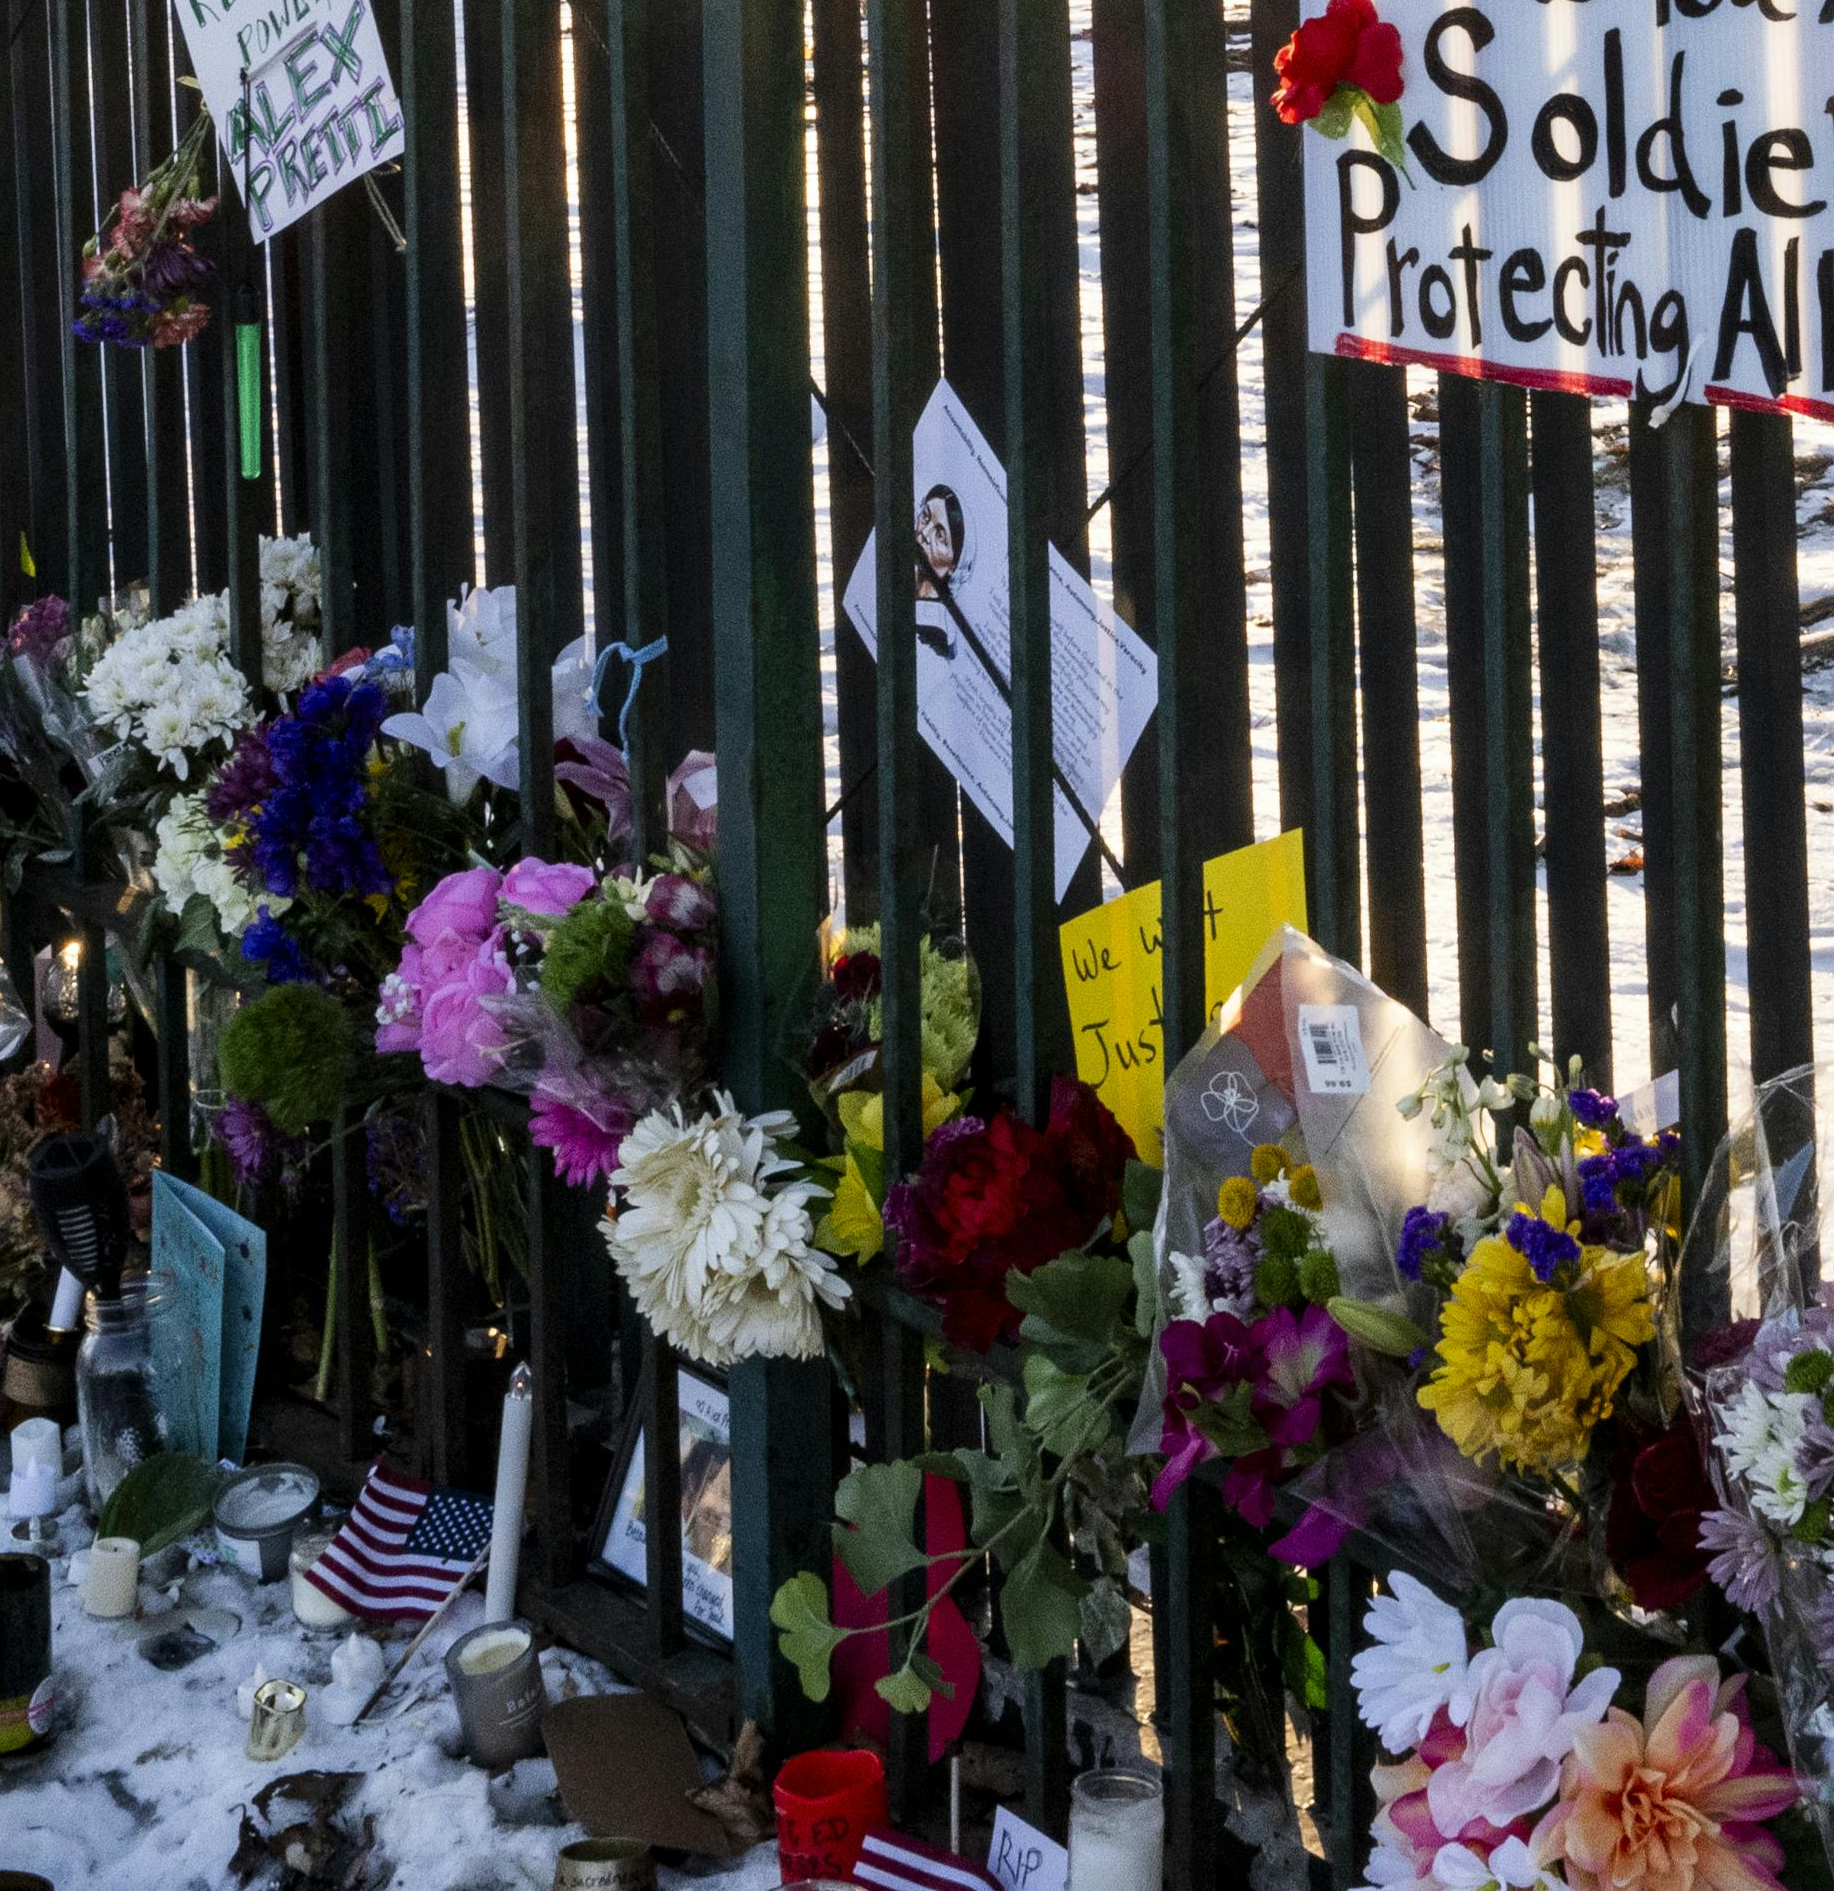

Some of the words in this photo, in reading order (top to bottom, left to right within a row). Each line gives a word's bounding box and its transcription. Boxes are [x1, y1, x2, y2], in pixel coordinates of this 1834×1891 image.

[248, 76, 404, 232] PRETTI
[1339, 148, 1692, 405] Protecting
[1072, 938, 1122, 982] We
[996, 1828, 1044, 1891] RIP
